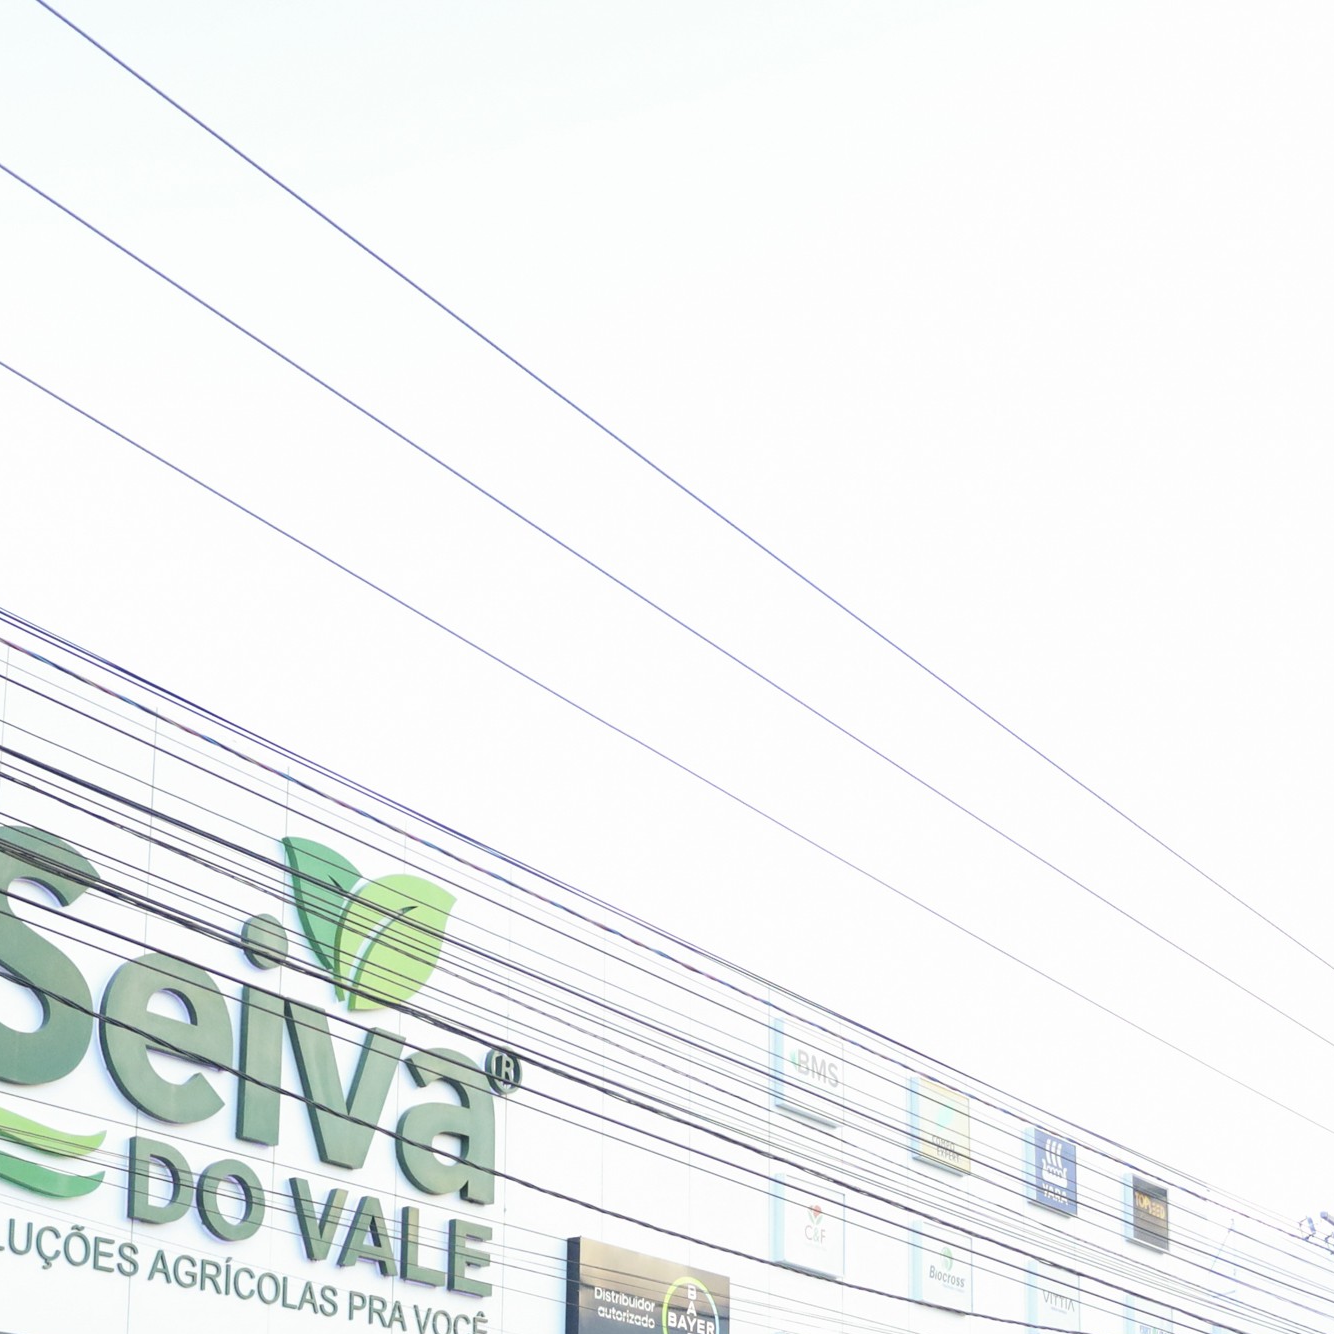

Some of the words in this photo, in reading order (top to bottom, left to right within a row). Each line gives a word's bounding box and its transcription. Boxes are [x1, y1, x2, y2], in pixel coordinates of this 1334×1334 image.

[797, 1049, 839, 1088] BMS
[1043, 1183, 1068, 1205] YARA
[127, 1136, 265, 1241] DO
[289, 1177, 493, 1297] VALE
[148, 1249, 338, 1317] AGRÍCOLAS
[349, 1290, 407, 1331] PRA
[594, 1287, 655, 1311] Distribuidor
[598, 1306, 655, 1329] autorizado
